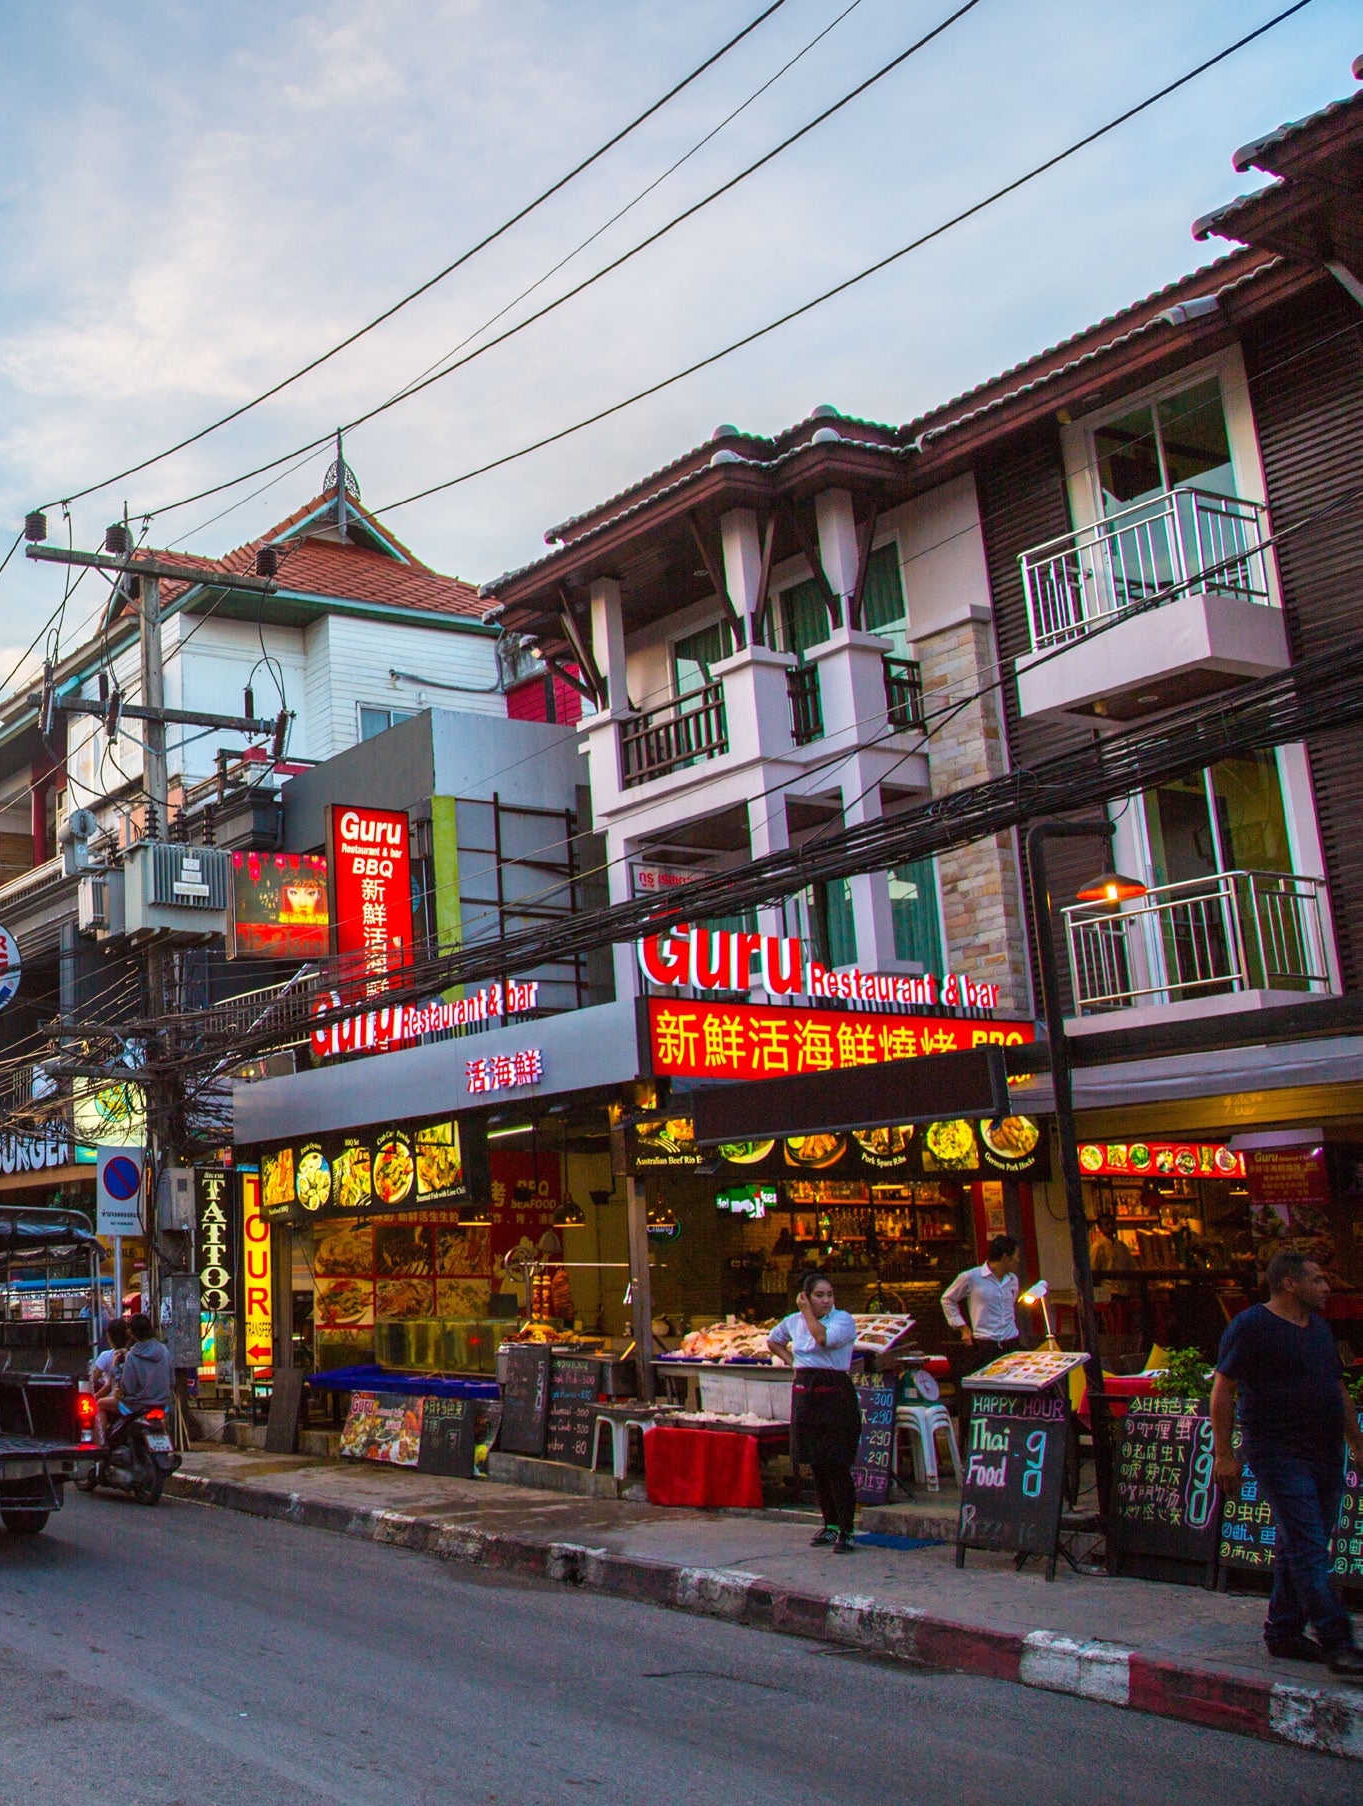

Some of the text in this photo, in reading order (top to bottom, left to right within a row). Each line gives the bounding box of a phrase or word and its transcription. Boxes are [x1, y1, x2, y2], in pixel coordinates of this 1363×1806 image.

[340, 811, 402, 846] Guru
[341, 842, 380, 857] Restaurant
[390, 848, 403, 859] bar
[352, 857, 394, 879] BBQ
[637, 908, 1000, 1009] Guru Restaurant & bar
[402, 988, 488, 1040] Restaurant
[488, 984, 505, 1017] &
[506, 979, 539, 1013] bar
[465, 1049, 543, 1094] 活海鮮
[636, 1157, 667, 1165] Australian
[668, 1156, 684, 1165] Beef
[861, 1152, 875, 1164] Pork
[1255, 1151, 1278, 1162] Guru
[199, 1180, 232, 1311] TATTOO
[245, 1179, 270, 1316] TOUR
[245, 1321, 272, 1338] TRANSFER
[972, 1394, 1064, 1418] HAPPY HOUR
[970, 1417, 1011, 1451] Thai
[966, 1454, 1007, 1488] Food
